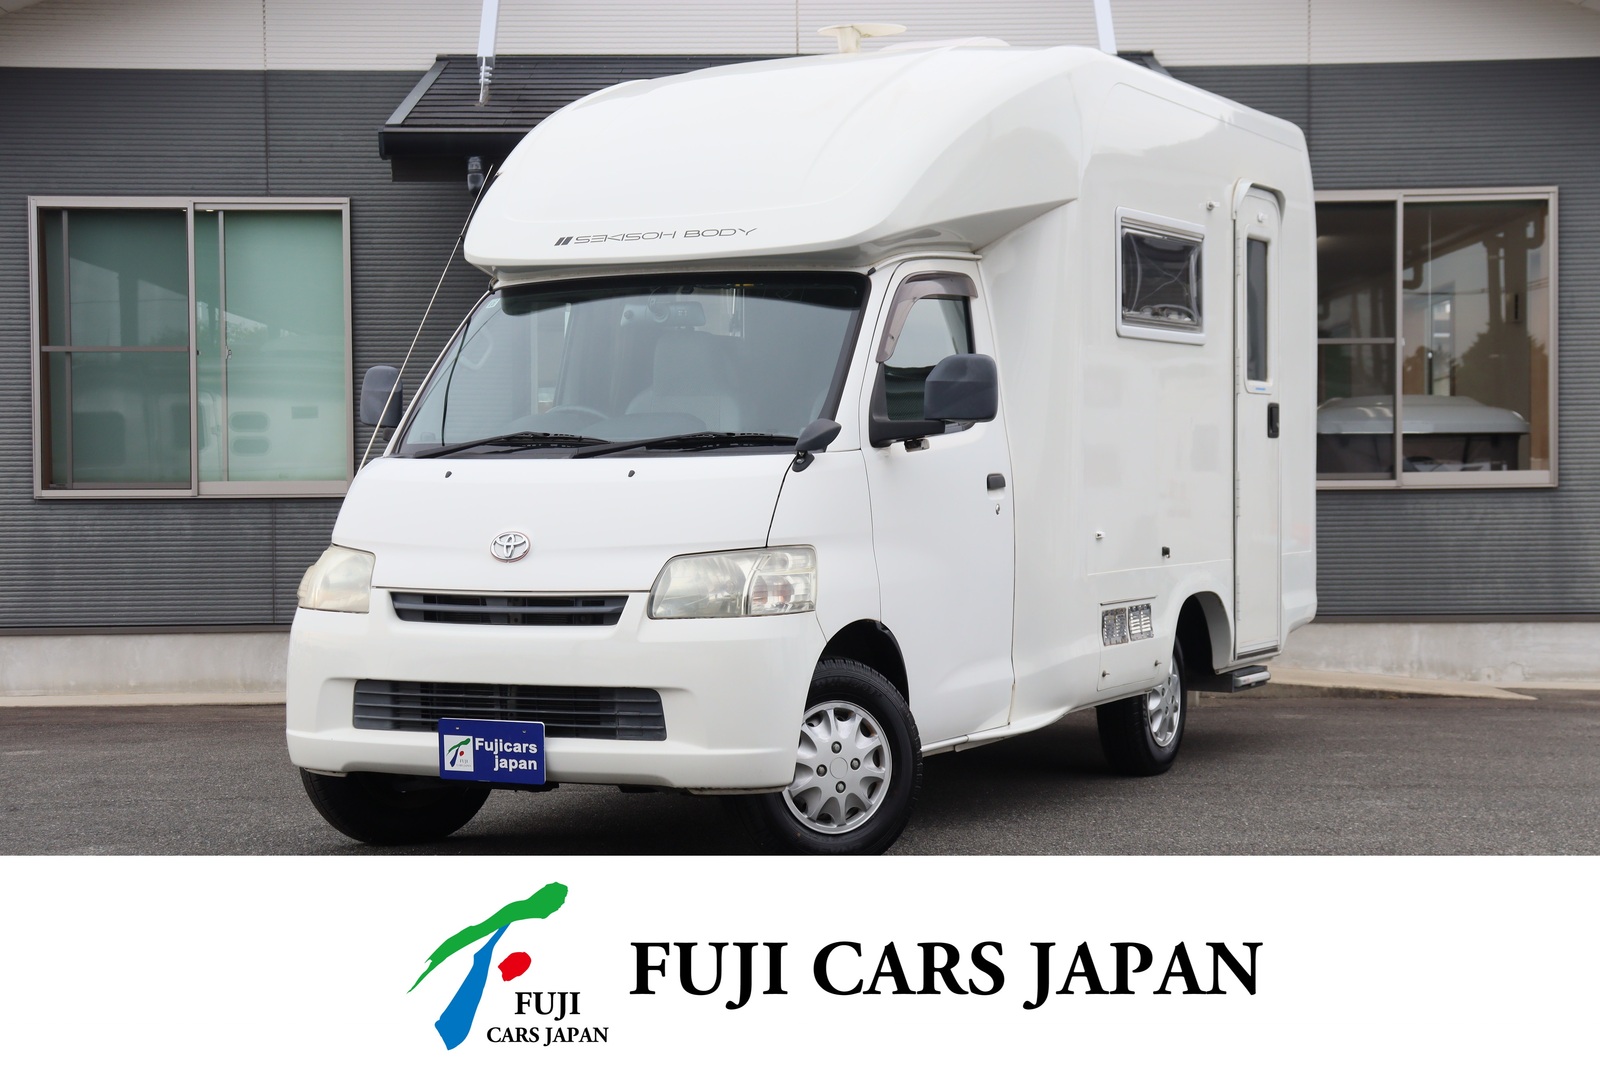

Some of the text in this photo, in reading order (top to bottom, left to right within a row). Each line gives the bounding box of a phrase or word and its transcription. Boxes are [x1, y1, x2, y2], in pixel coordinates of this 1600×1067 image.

[574, 228, 757, 245] SEKISOH BODY
[474, 737, 538, 755] Fujicars
[493, 755, 538, 772] japan
